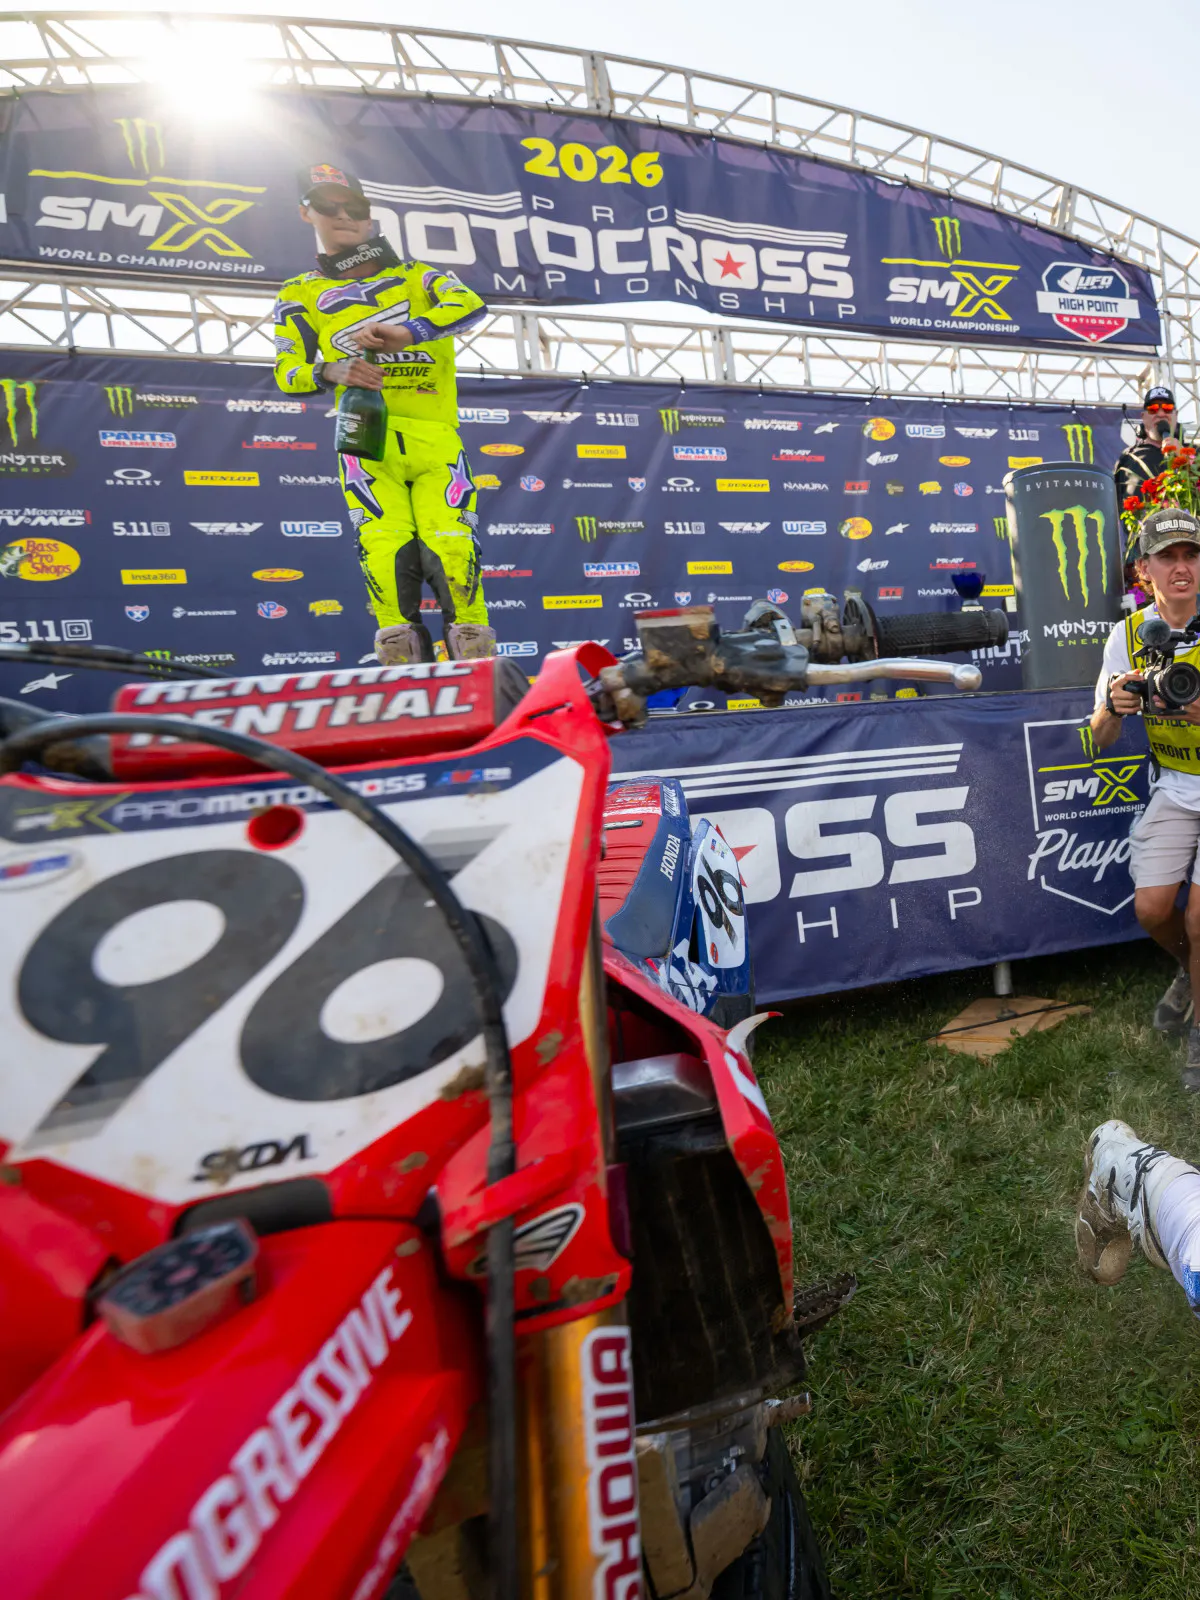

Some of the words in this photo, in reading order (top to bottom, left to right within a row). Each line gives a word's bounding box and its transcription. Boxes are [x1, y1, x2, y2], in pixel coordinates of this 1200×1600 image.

[520, 137, 664, 188] 2026
[532, 194, 669, 223] PRO
[36, 191, 255, 259] SMX
[38, 245, 113, 263] WORLD
[116, 253, 266, 274] CHAMPIONSHIP
[335, 246, 380, 272] 100PRCNT
[1078, 275, 1113, 287] UFO
[448, 269, 857, 319] MPIONSHIP
[886, 271, 1013, 321] SMX
[1058, 298, 1085, 311] HIGH
[1087, 300, 1119, 313] POINT
[889, 315, 932, 328] WORLD
[934, 319, 1020, 333] CHAMPIONSHIP
[1063, 316, 1119, 326] NATIONAL
[376, 351, 435, 364] NDA
[135, 393, 199, 404] MONSTER
[458, 409, 507, 422] WPS
[595, 412, 625, 426] 5.11
[681, 414, 725, 424] MONSTER
[101, 431, 174, 442] PARTS
[906, 425, 945, 437] WPS
[954, 427, 998, 437] FLY
[1008, 429, 1028, 441] 5.11
[674, 447, 726, 456] PARTS
[0, 453, 66, 466] NSTER
[279, 474, 341, 484] NAMURA
[520, 475, 536, 489] VP
[1036, 480, 1104, 490] VITAMINS
[783, 482, 829, 490] NAMURA
[23, 508, 84, 516] MOUNTAIN
[112, 522, 151, 536] 5.11
[190, 522, 264, 533] FLY
[282, 522, 340, 536] WPS
[598, 521, 645, 529] MONSTER
[664, 522, 691, 535] 5.11
[718, 522, 771, 532] FLY
[783, 521, 826, 534] WPS
[1156, 520, 1178, 532] WORLD
[26, 540, 60, 552] Bass
[27, 552, 54, 565] Pro
[30, 563, 73, 577] Shops
[131, 573, 177, 581] Insta360
[767, 588, 780, 603] VP
[918, 588, 959, 596] NAMURA
[257, 602, 277, 617] VP
[484, 599, 527, 609] AMURA
[0, 620, 61, 642] 5.11
[1043, 619, 1116, 639] MONSTE
[624, 638, 643, 651] 5.1
[1057, 638, 1108, 647] ENER
[174, 652, 235, 662] MONSTER
[1152, 741, 1191, 761] FRONT
[1041, 765, 1140, 806] SMX
[1044, 811, 1077, 822] WORLD
[1079, 803, 1146, 818] CHAMPIONSHIP
[659, 833, 681, 882] HONDA
[1027, 828, 1132, 883] Playo
[697, 852, 744, 949] 96
[12, 824, 520, 1155] 96
[125, 1263, 413, 1600] OGRESSIVE
